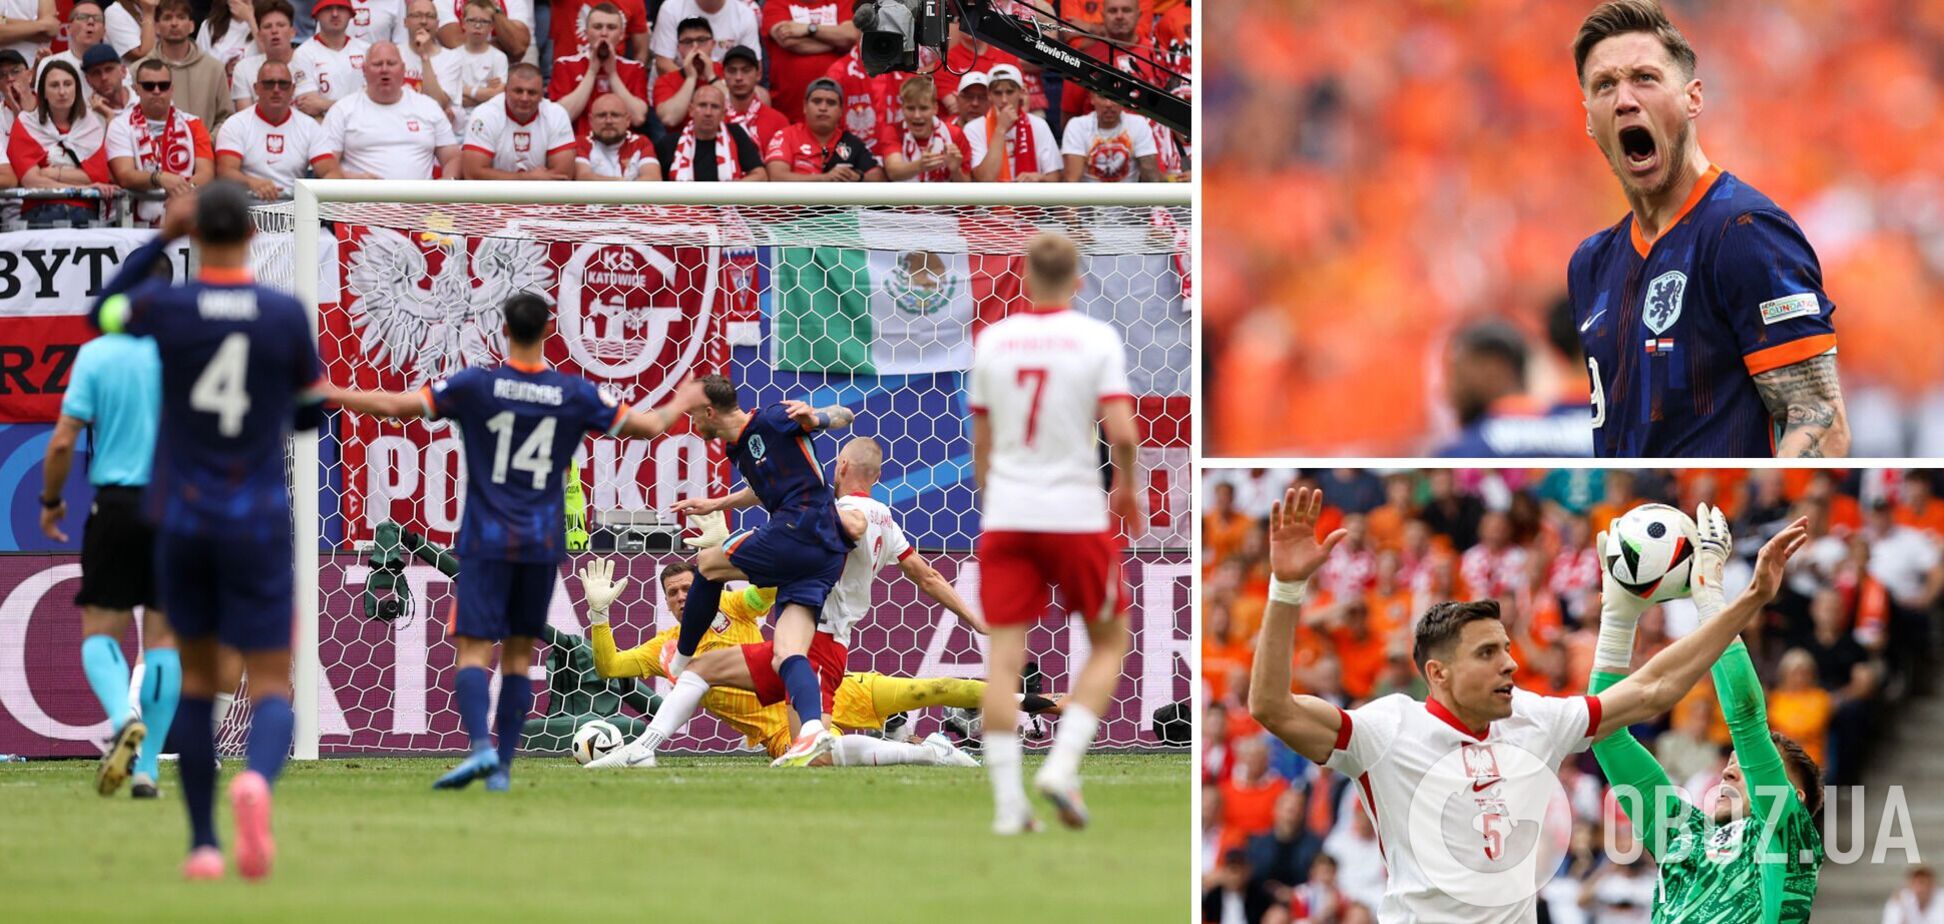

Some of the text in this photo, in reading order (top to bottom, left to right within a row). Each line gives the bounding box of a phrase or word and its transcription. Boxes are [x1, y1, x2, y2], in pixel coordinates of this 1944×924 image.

[1035, 39, 1081, 69] MovieTech
[318, 72, 331, 94] 5
[587, 271, 647, 288] KATOWICE
[603, 249, 635, 272] KS
[189, 331, 252, 439] 4
[1015, 366, 1049, 448] 7
[485, 410, 558, 490] 14
[365, 434, 709, 533] POKA
[1482, 813, 1502, 861] 5
